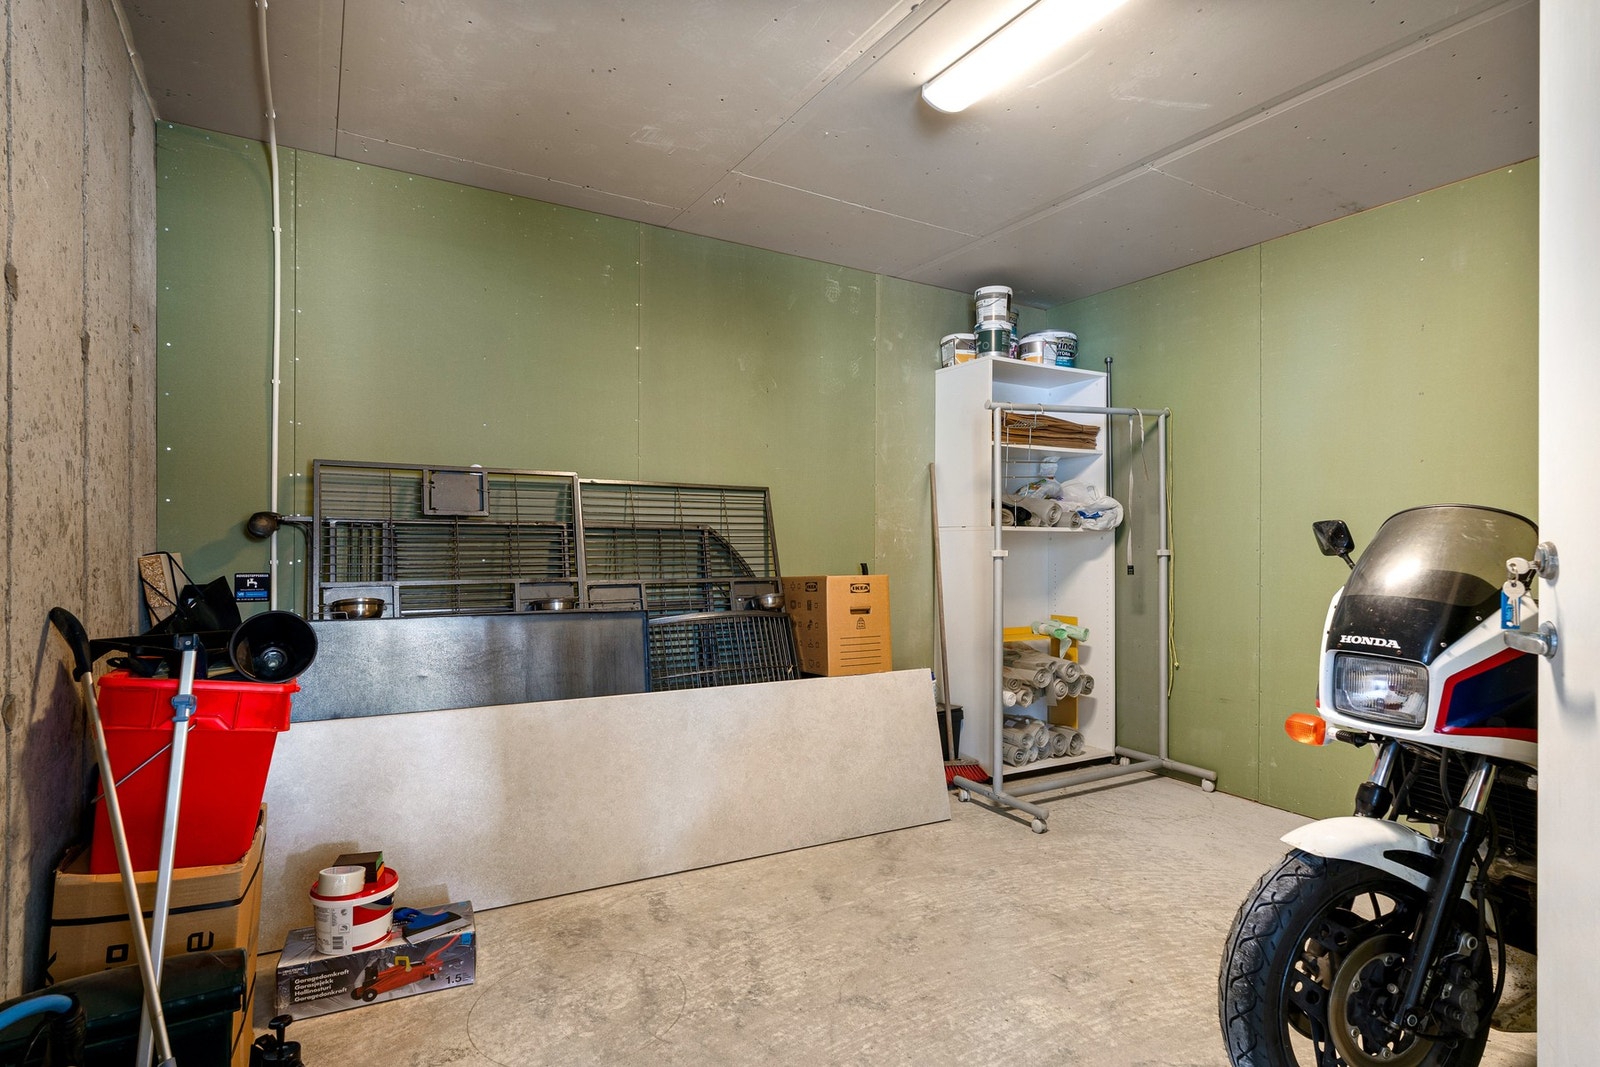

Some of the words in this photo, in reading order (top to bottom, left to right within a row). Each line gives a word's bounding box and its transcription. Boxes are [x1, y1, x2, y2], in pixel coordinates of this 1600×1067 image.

[1340, 635, 1401, 649] HONDA
[294, 969, 350, 984] Garagedomkraft
[446, 974, 462, 984] 1.5
[294, 979, 334, 991] Garasjejekk
[294, 985, 332, 997] Hallinosturi
[294, 987, 348, 1002] Garagedonkraft
